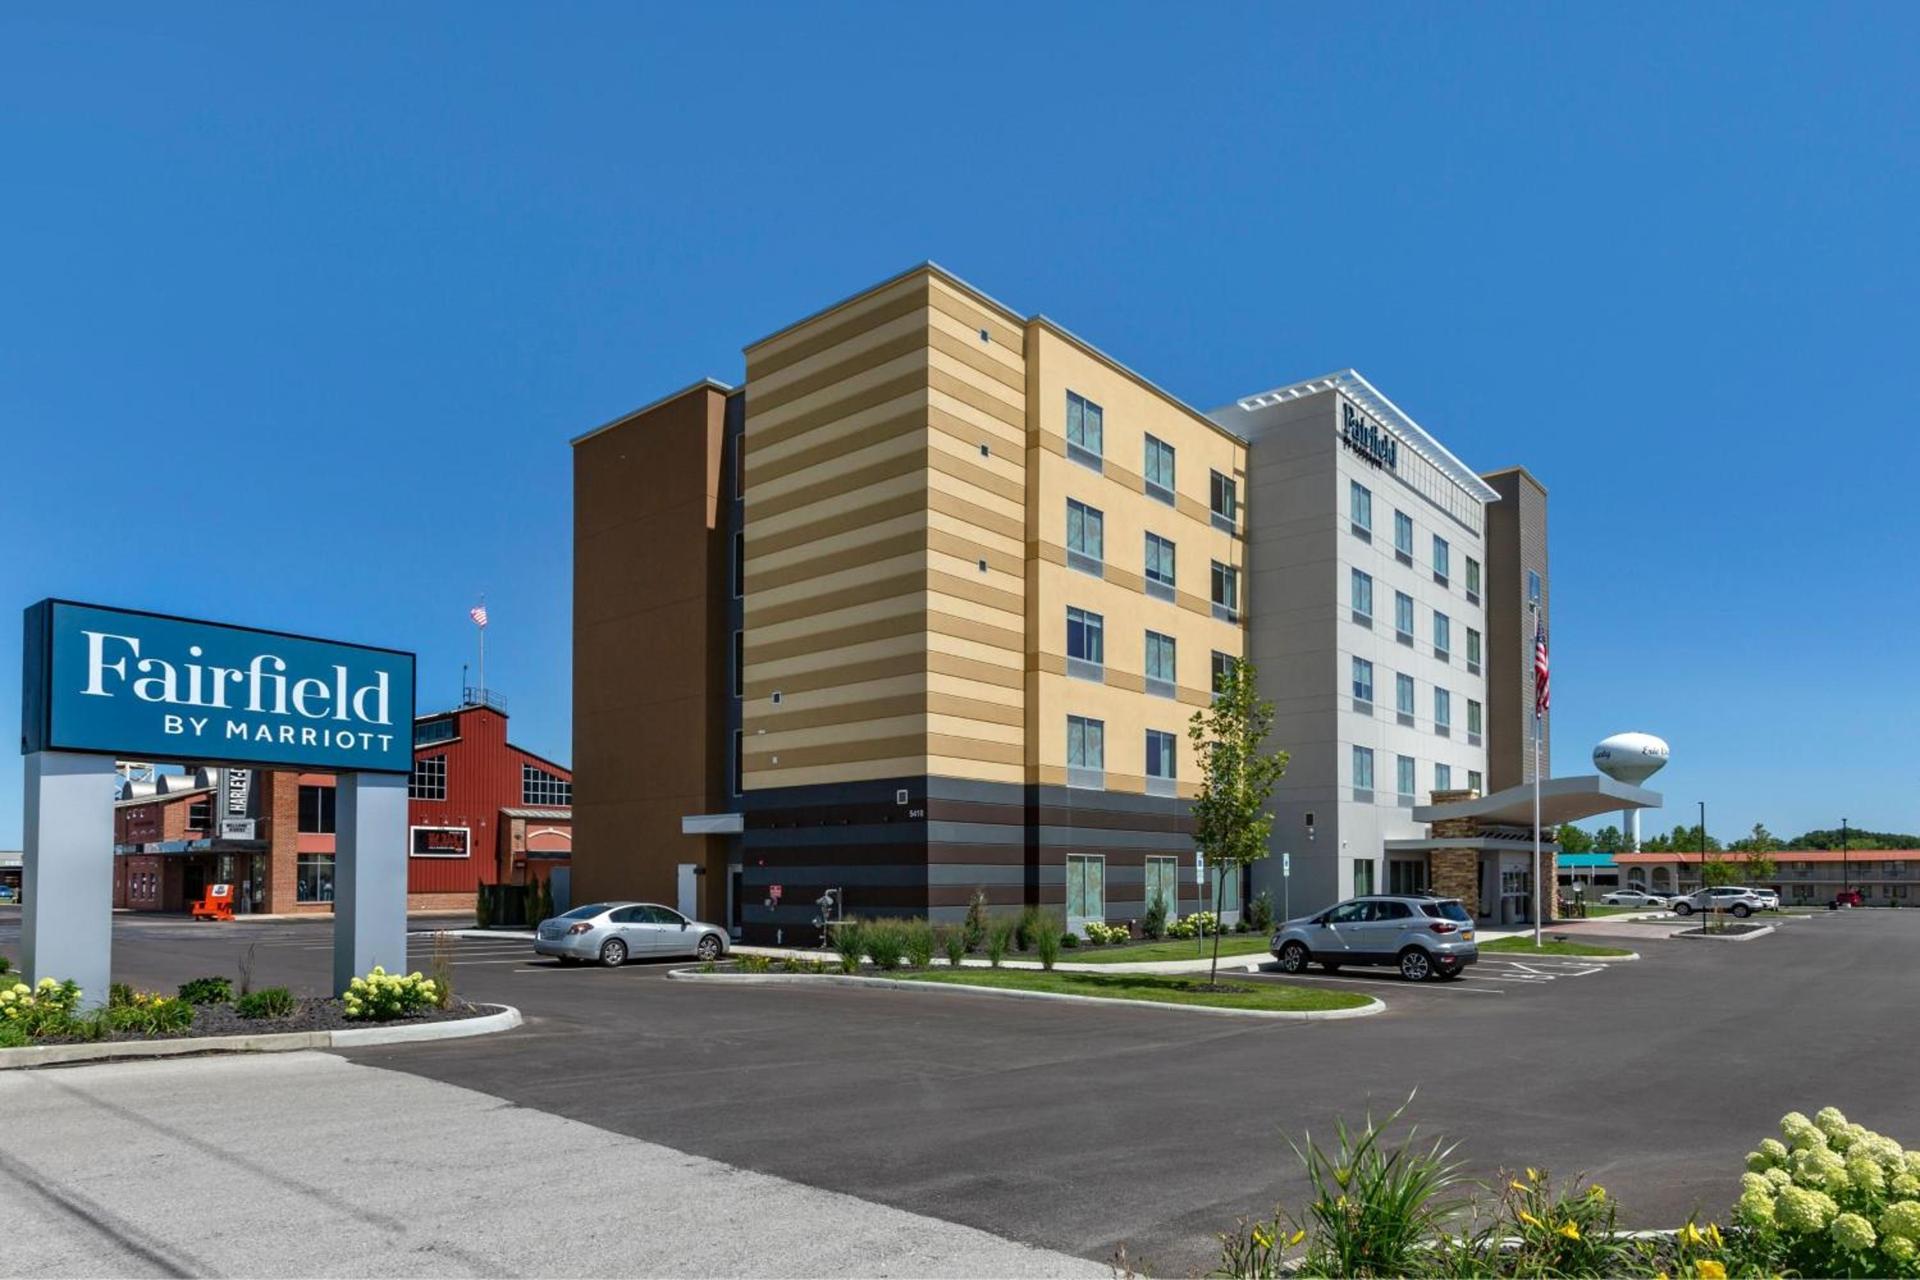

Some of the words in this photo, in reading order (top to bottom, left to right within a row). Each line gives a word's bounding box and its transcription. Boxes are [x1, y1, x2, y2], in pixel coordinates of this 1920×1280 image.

[80, 630, 393, 725] Fairfield
[164, 714, 208, 736] BY
[226, 720, 394, 752] MARRIOTT
